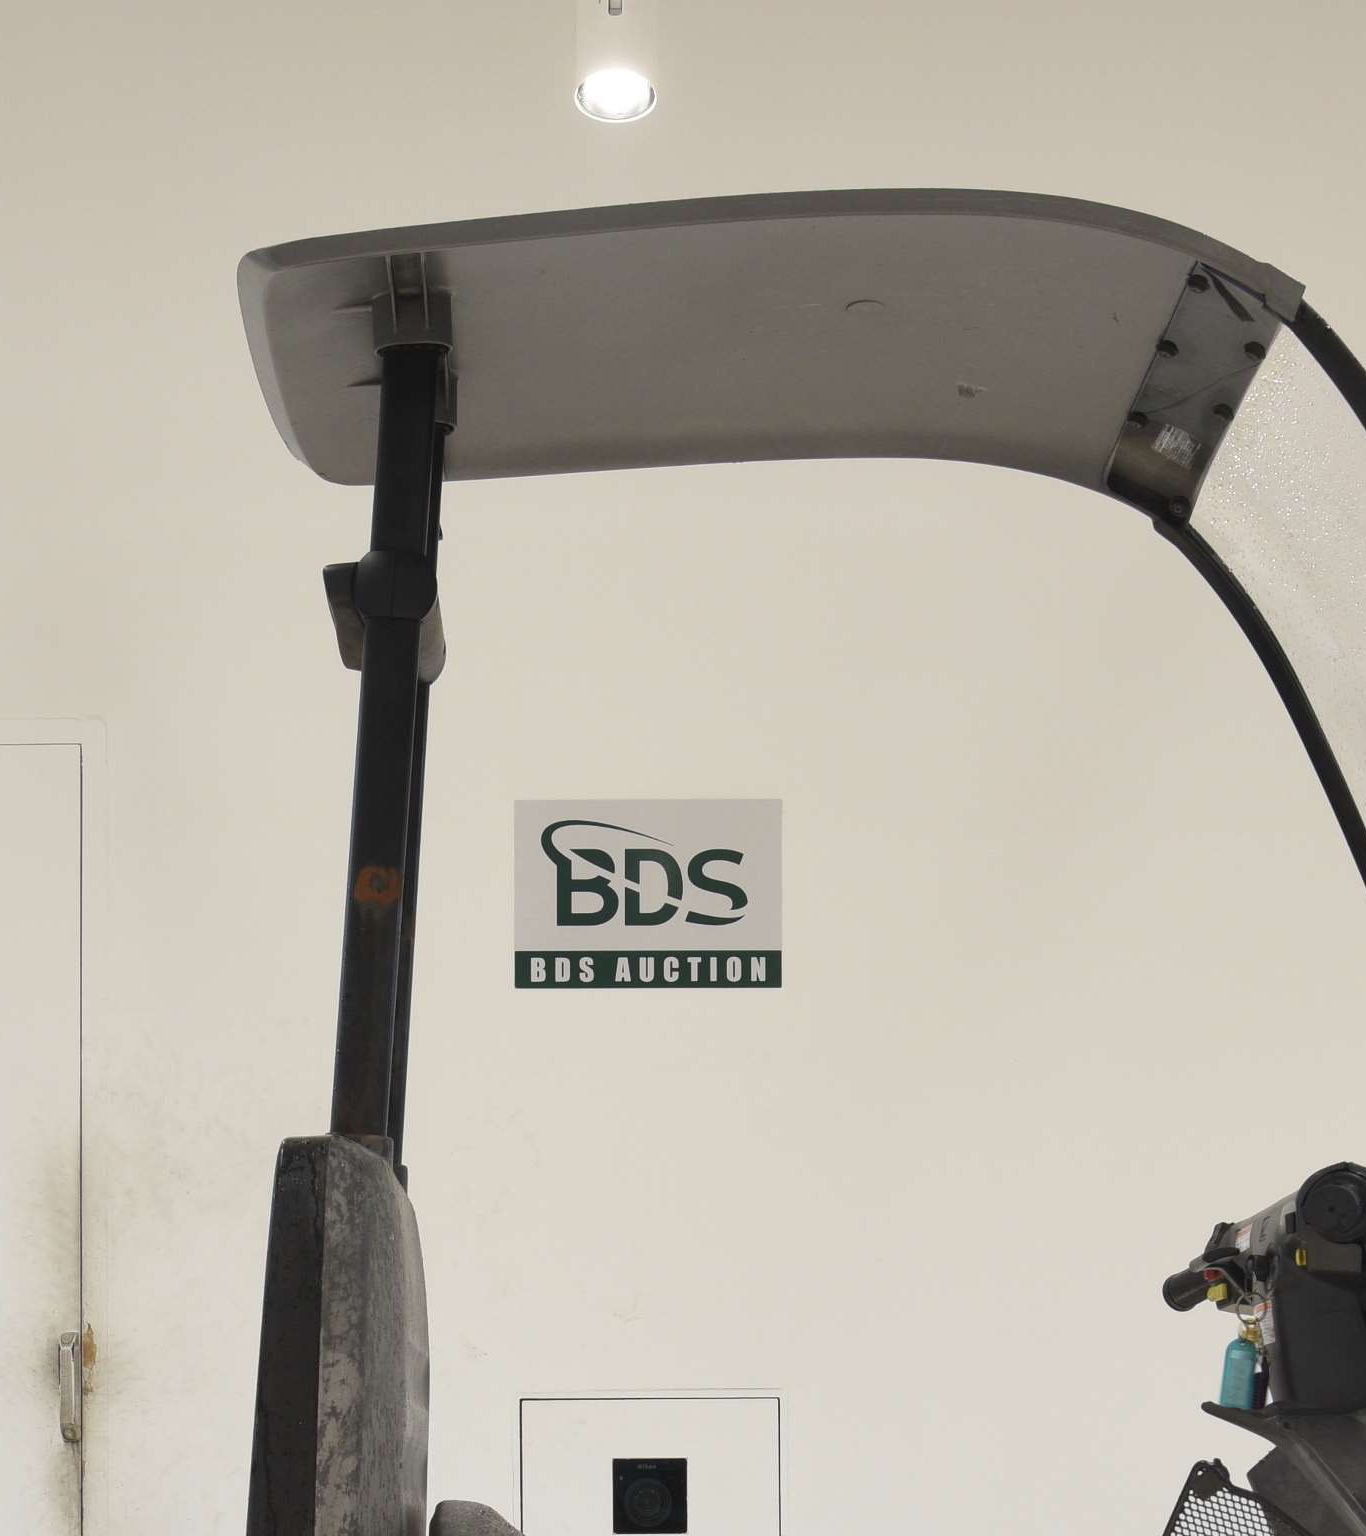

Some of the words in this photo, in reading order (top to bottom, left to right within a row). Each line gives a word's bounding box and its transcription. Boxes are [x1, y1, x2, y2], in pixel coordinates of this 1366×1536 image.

[554, 847, 749, 926] BDS
[530, 956, 595, 983] BDS
[614, 956, 767, 983] AUCTION
